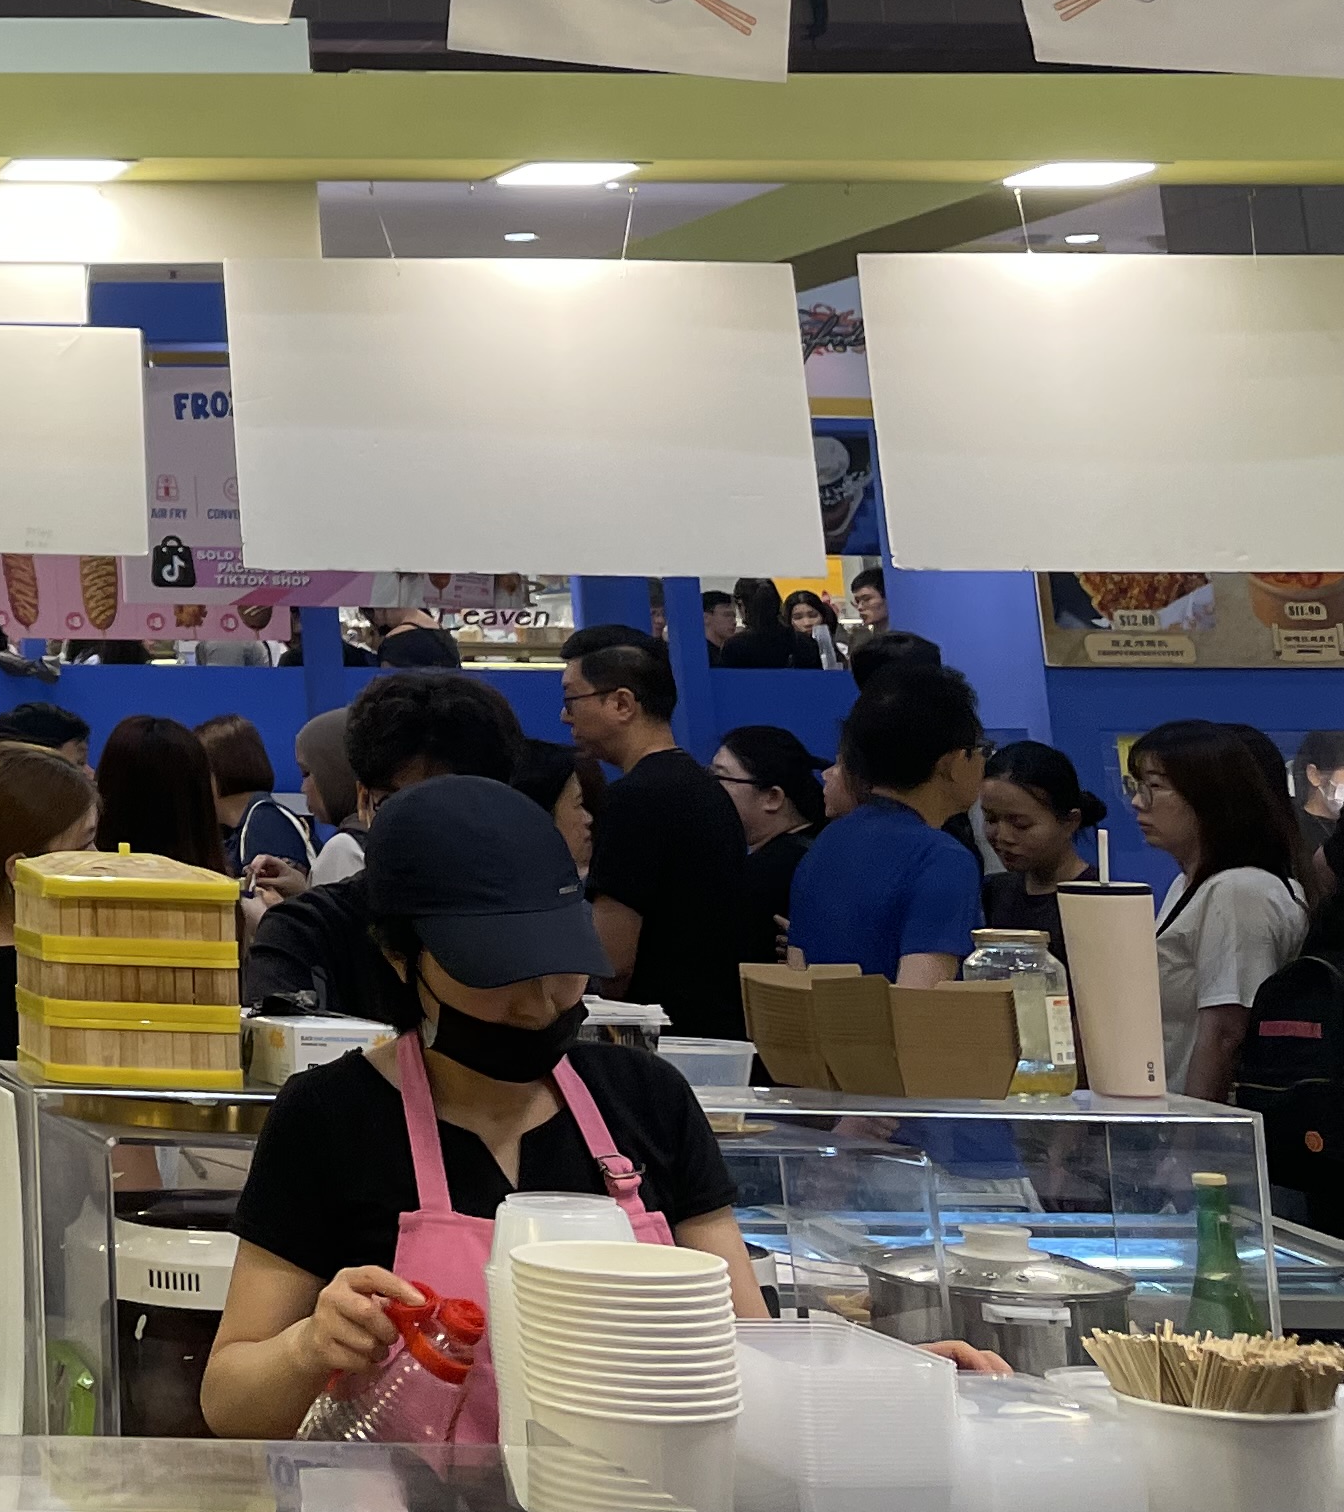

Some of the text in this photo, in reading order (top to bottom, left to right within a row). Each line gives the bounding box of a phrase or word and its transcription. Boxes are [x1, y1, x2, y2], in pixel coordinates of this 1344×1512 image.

[173, 390, 233, 420] FRO
[215, 574, 311, 587] TIKTOK SHOP
[462, 609, 550, 626] eaven
